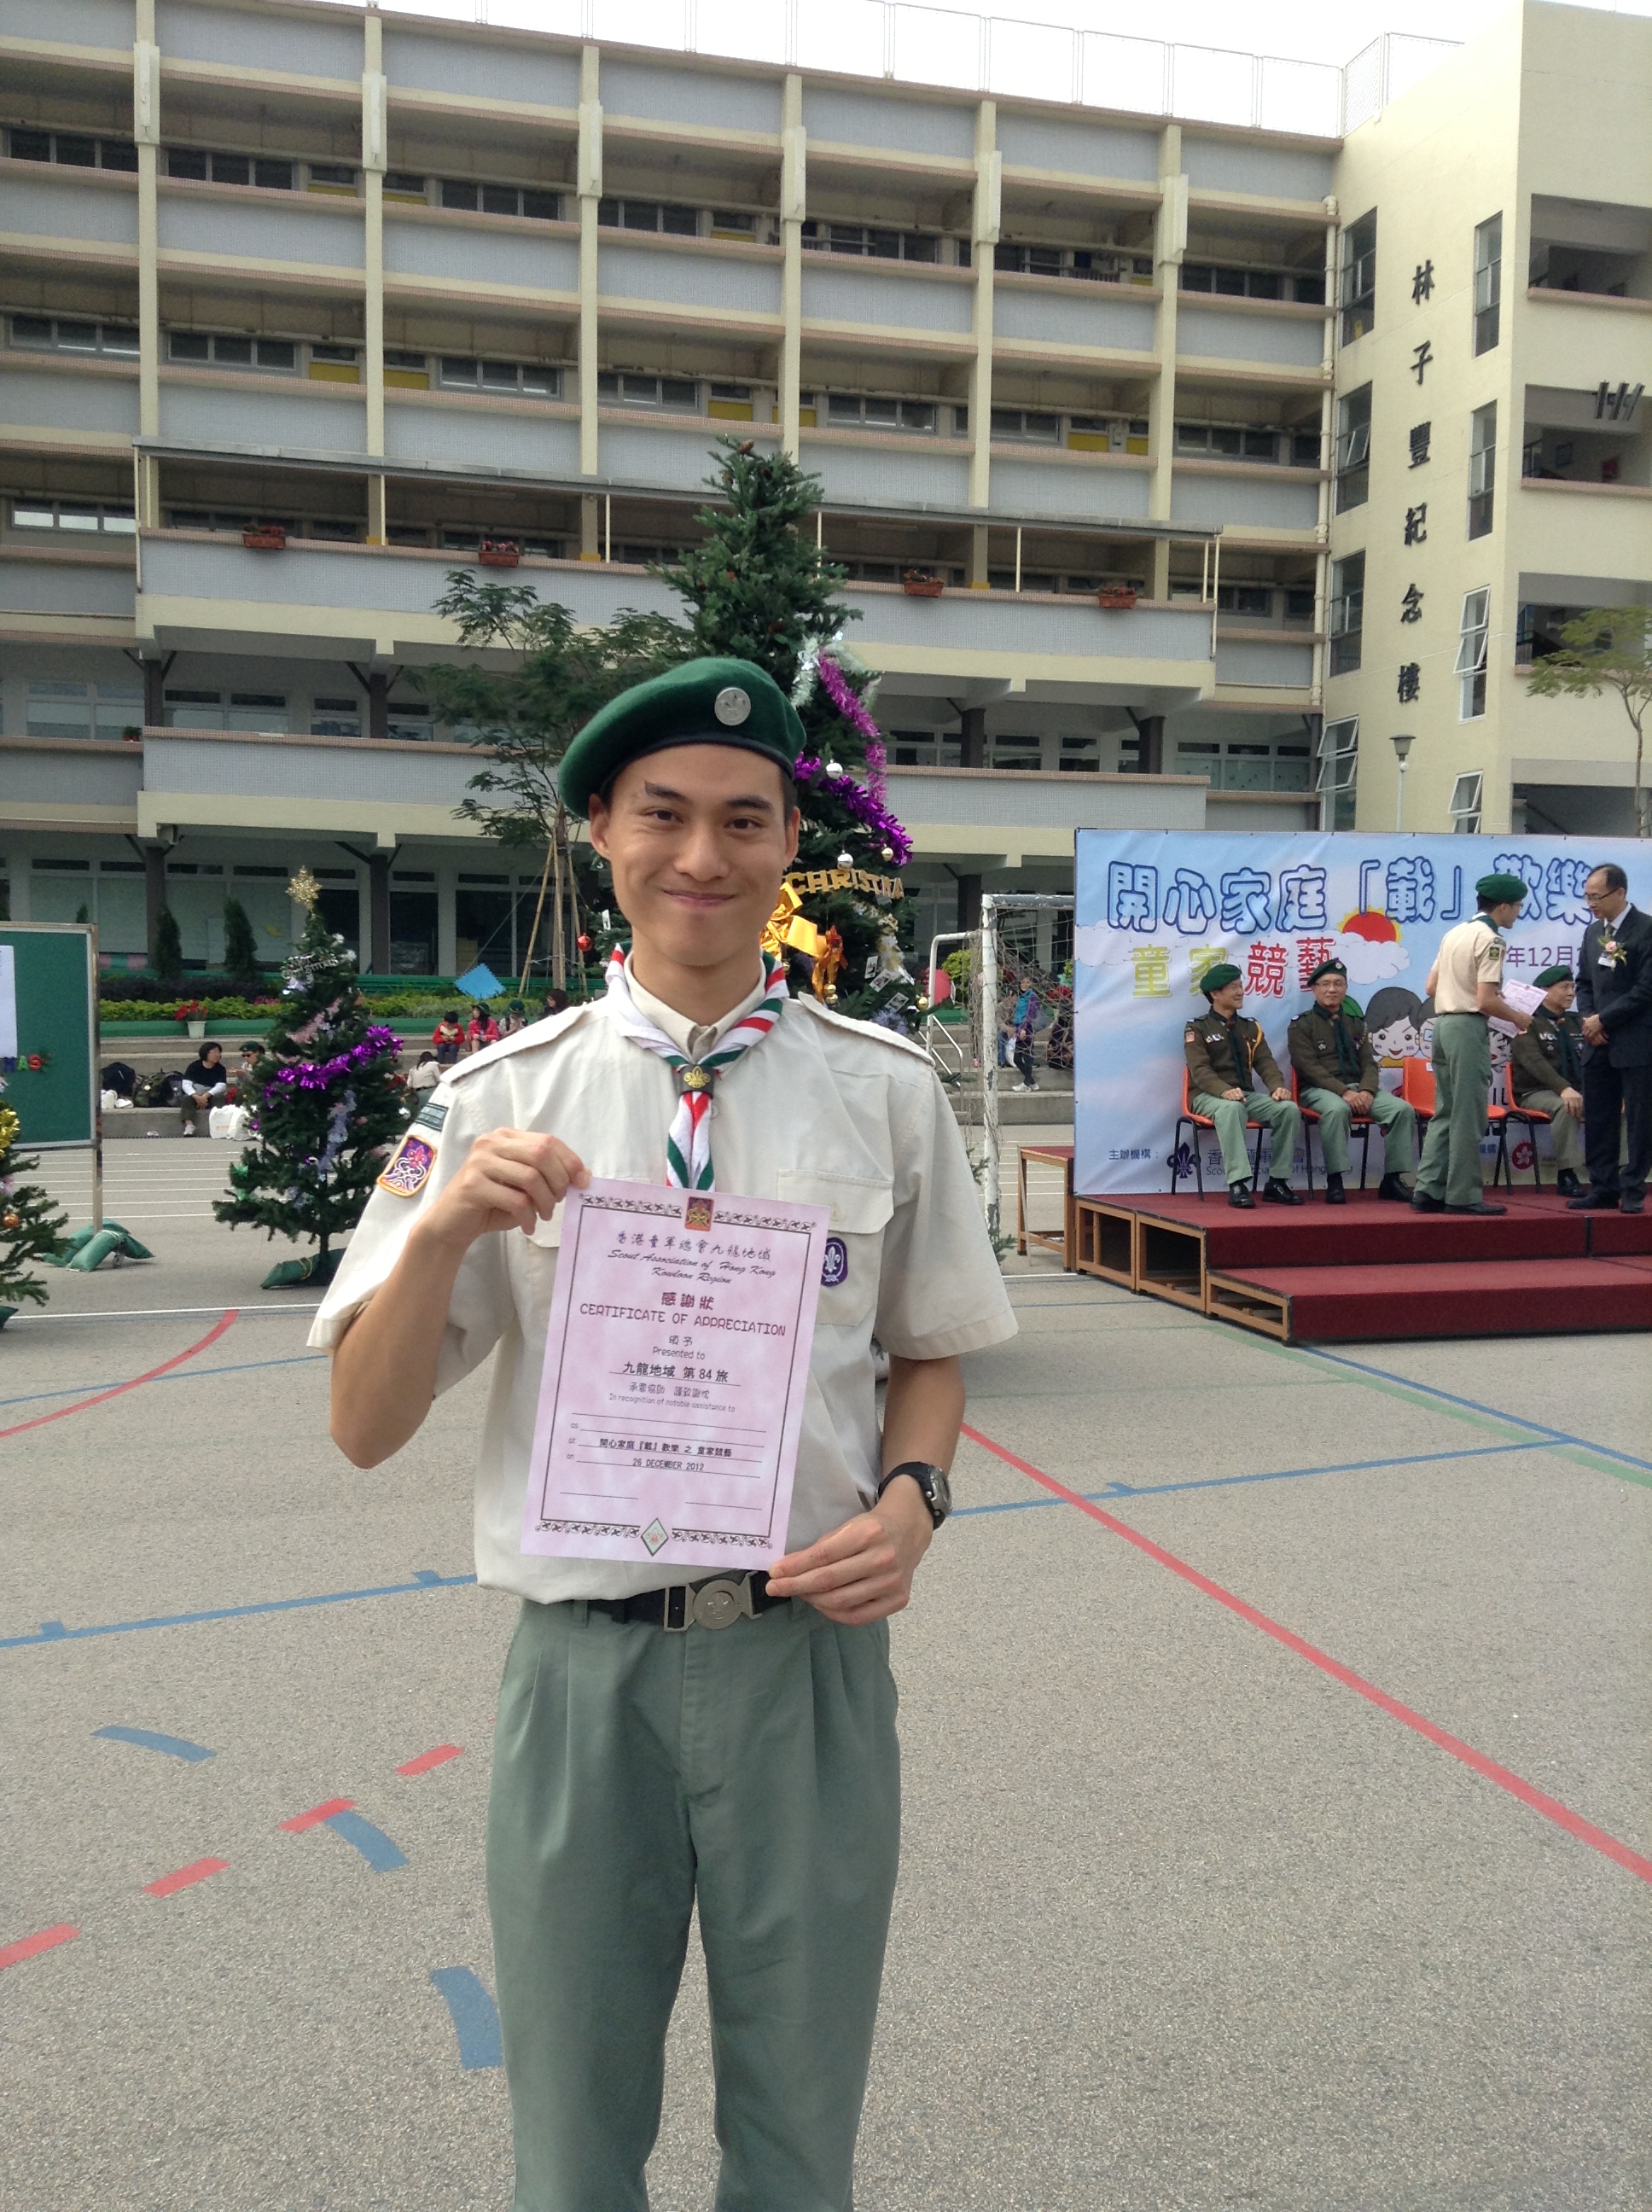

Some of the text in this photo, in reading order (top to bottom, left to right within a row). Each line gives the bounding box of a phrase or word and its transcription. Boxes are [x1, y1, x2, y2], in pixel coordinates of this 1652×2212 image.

[1396, 259, 1435, 705] 林子豐紀念樓
[1506, 946, 1581, 969] 年12月
[608, 1249, 776, 1278] Scout Association of Hong Kong
[651, 1266, 731, 1285] Kowloon Region
[661, 1291, 715, 1310] 感謝狀
[579, 1302, 787, 1336] CERTIFICATE OF APPRECIATION
[652, 1346, 706, 1361] Presented to
[623, 1362, 676, 1378] 九龍地域
[698, 1369, 713, 1380] 84
[715, 1369, 729, 1382] 旅
[617, 1394, 654, 1406] recognition
[666, 1399, 690, 1409] notable
[691, 1400, 725, 1412] assistance
[632, 1458, 705, 1471] 26 DECEMBER 2012
